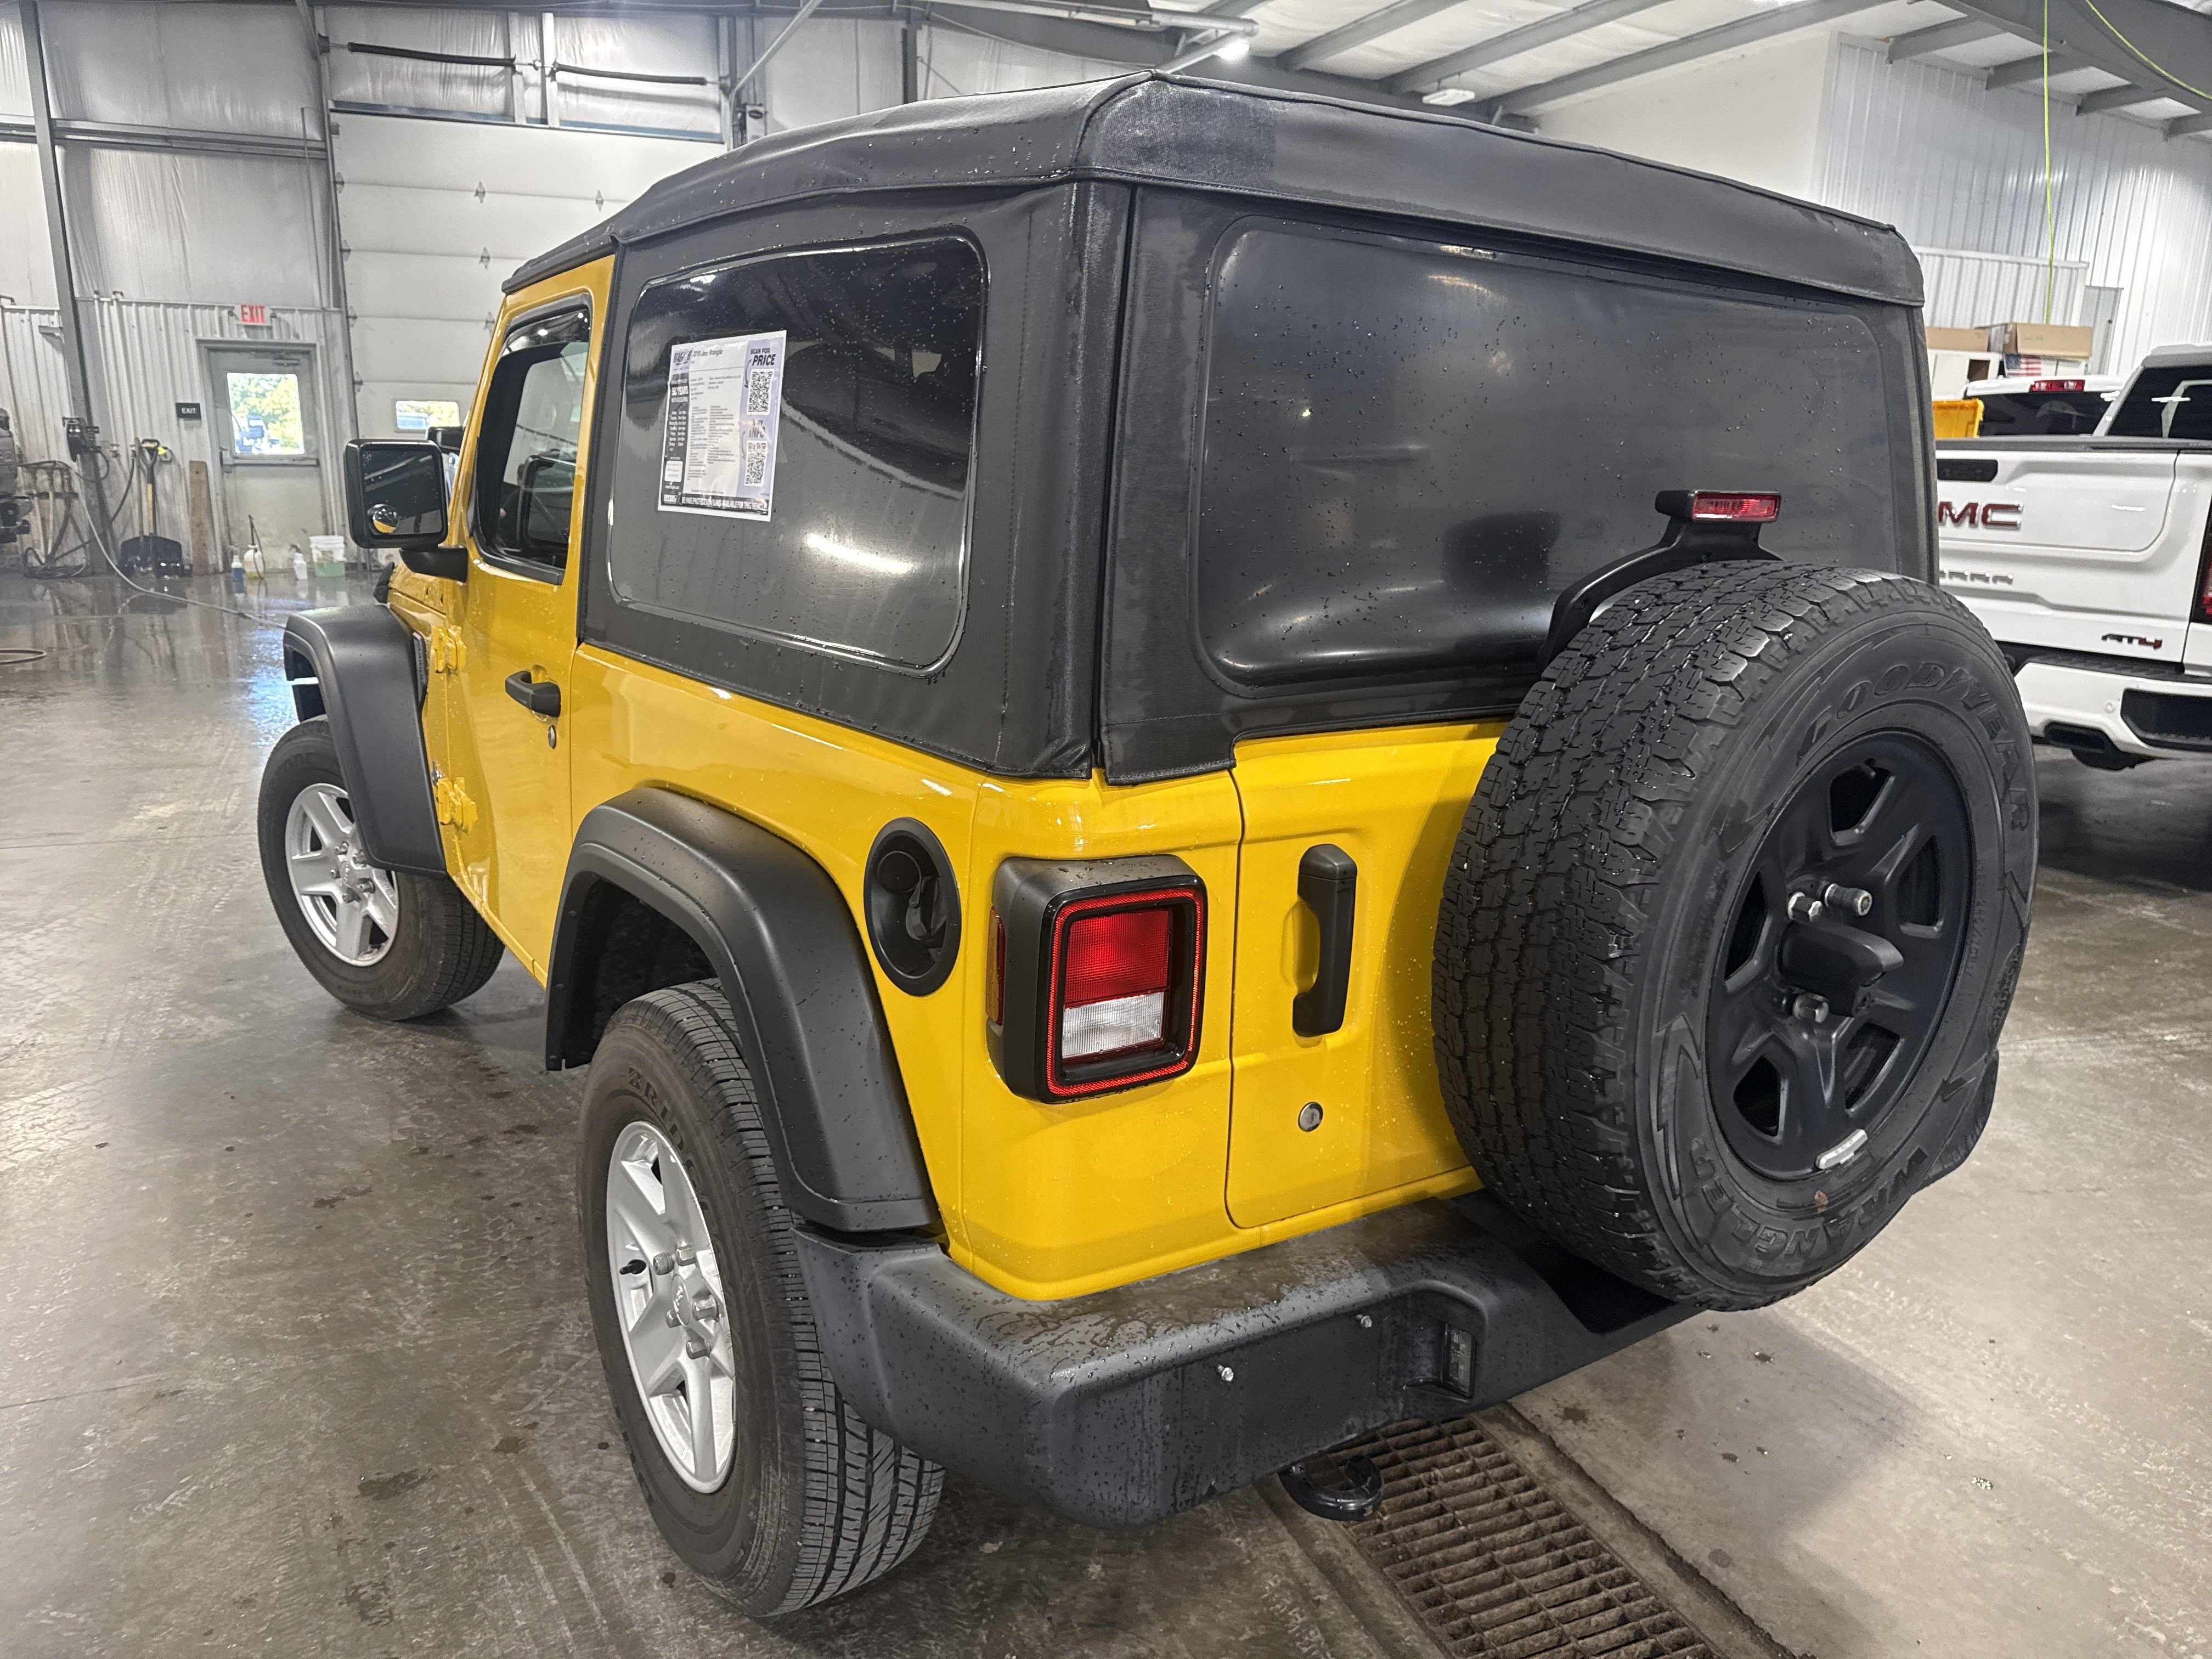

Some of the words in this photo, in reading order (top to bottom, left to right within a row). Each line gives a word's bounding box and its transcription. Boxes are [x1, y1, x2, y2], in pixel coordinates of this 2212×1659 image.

[240, 304, 265, 323] EXIT
[752, 354, 776, 366] PRICE
[2101, 634, 2163, 650] AT4
[1796, 661, 2030, 832] GOODYEAR
